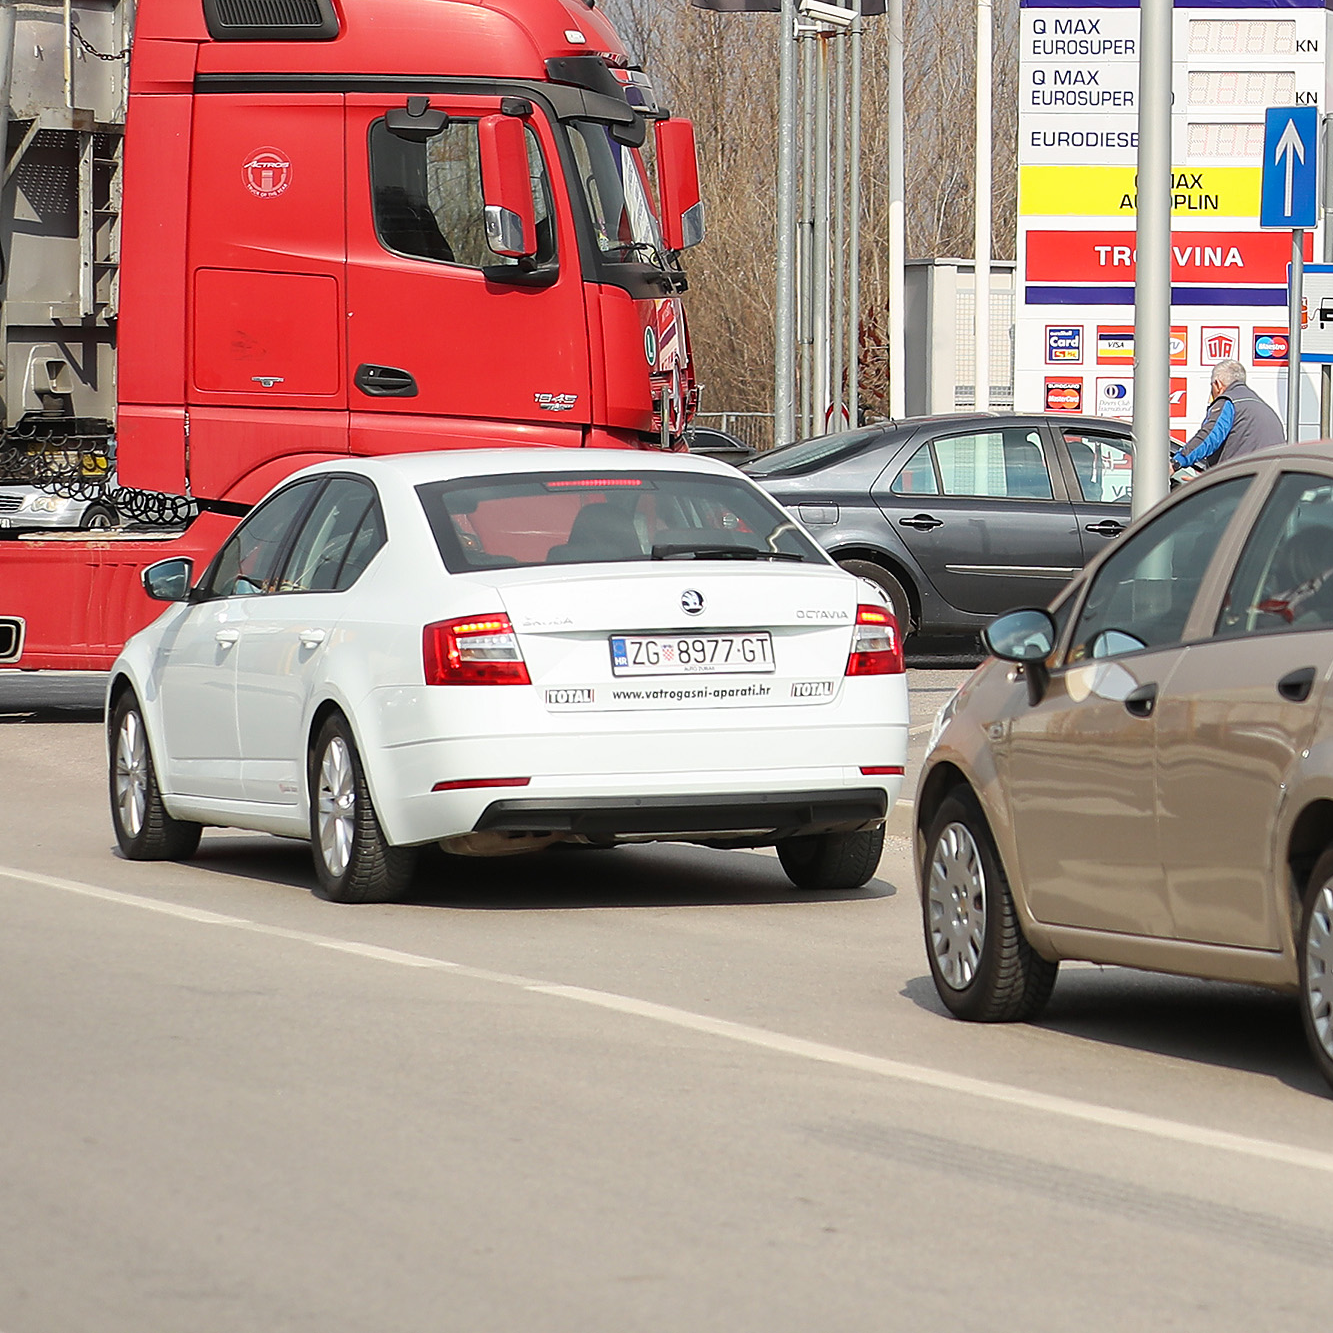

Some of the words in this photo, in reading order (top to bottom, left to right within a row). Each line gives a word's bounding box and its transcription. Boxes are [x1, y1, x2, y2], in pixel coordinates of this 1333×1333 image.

[1032, 19, 1047, 35] Q
[1054, 19, 1101, 35] MAX
[1032, 40, 1136, 55] EUROSUPER
[1296, 40, 1319, 53] KN
[1032, 70, 1046, 85] Q
[1053, 70, 1100, 85] MAX
[1031, 91, 1135, 106] EUROSUPER
[1295, 92, 1318, 105] KN
[1031, 132, 1139, 147] EURODIESE
[1120, 194, 1219, 210] APLIN
[1094, 245, 1245, 267] TRVINA
[1050, 336, 1079, 348] Card
[1208, 335, 1233, 358] UTA
[1258, 342, 1286, 351] Maestro
[795, 609, 849, 620] OCTAVIA
[629, 641, 660, 666] ZG
[549, 690, 592, 704] TOTAL
[612, 685, 772, 701] www.vatrogasni-aparati.hr
[794, 682, 832, 697] TOTAL
